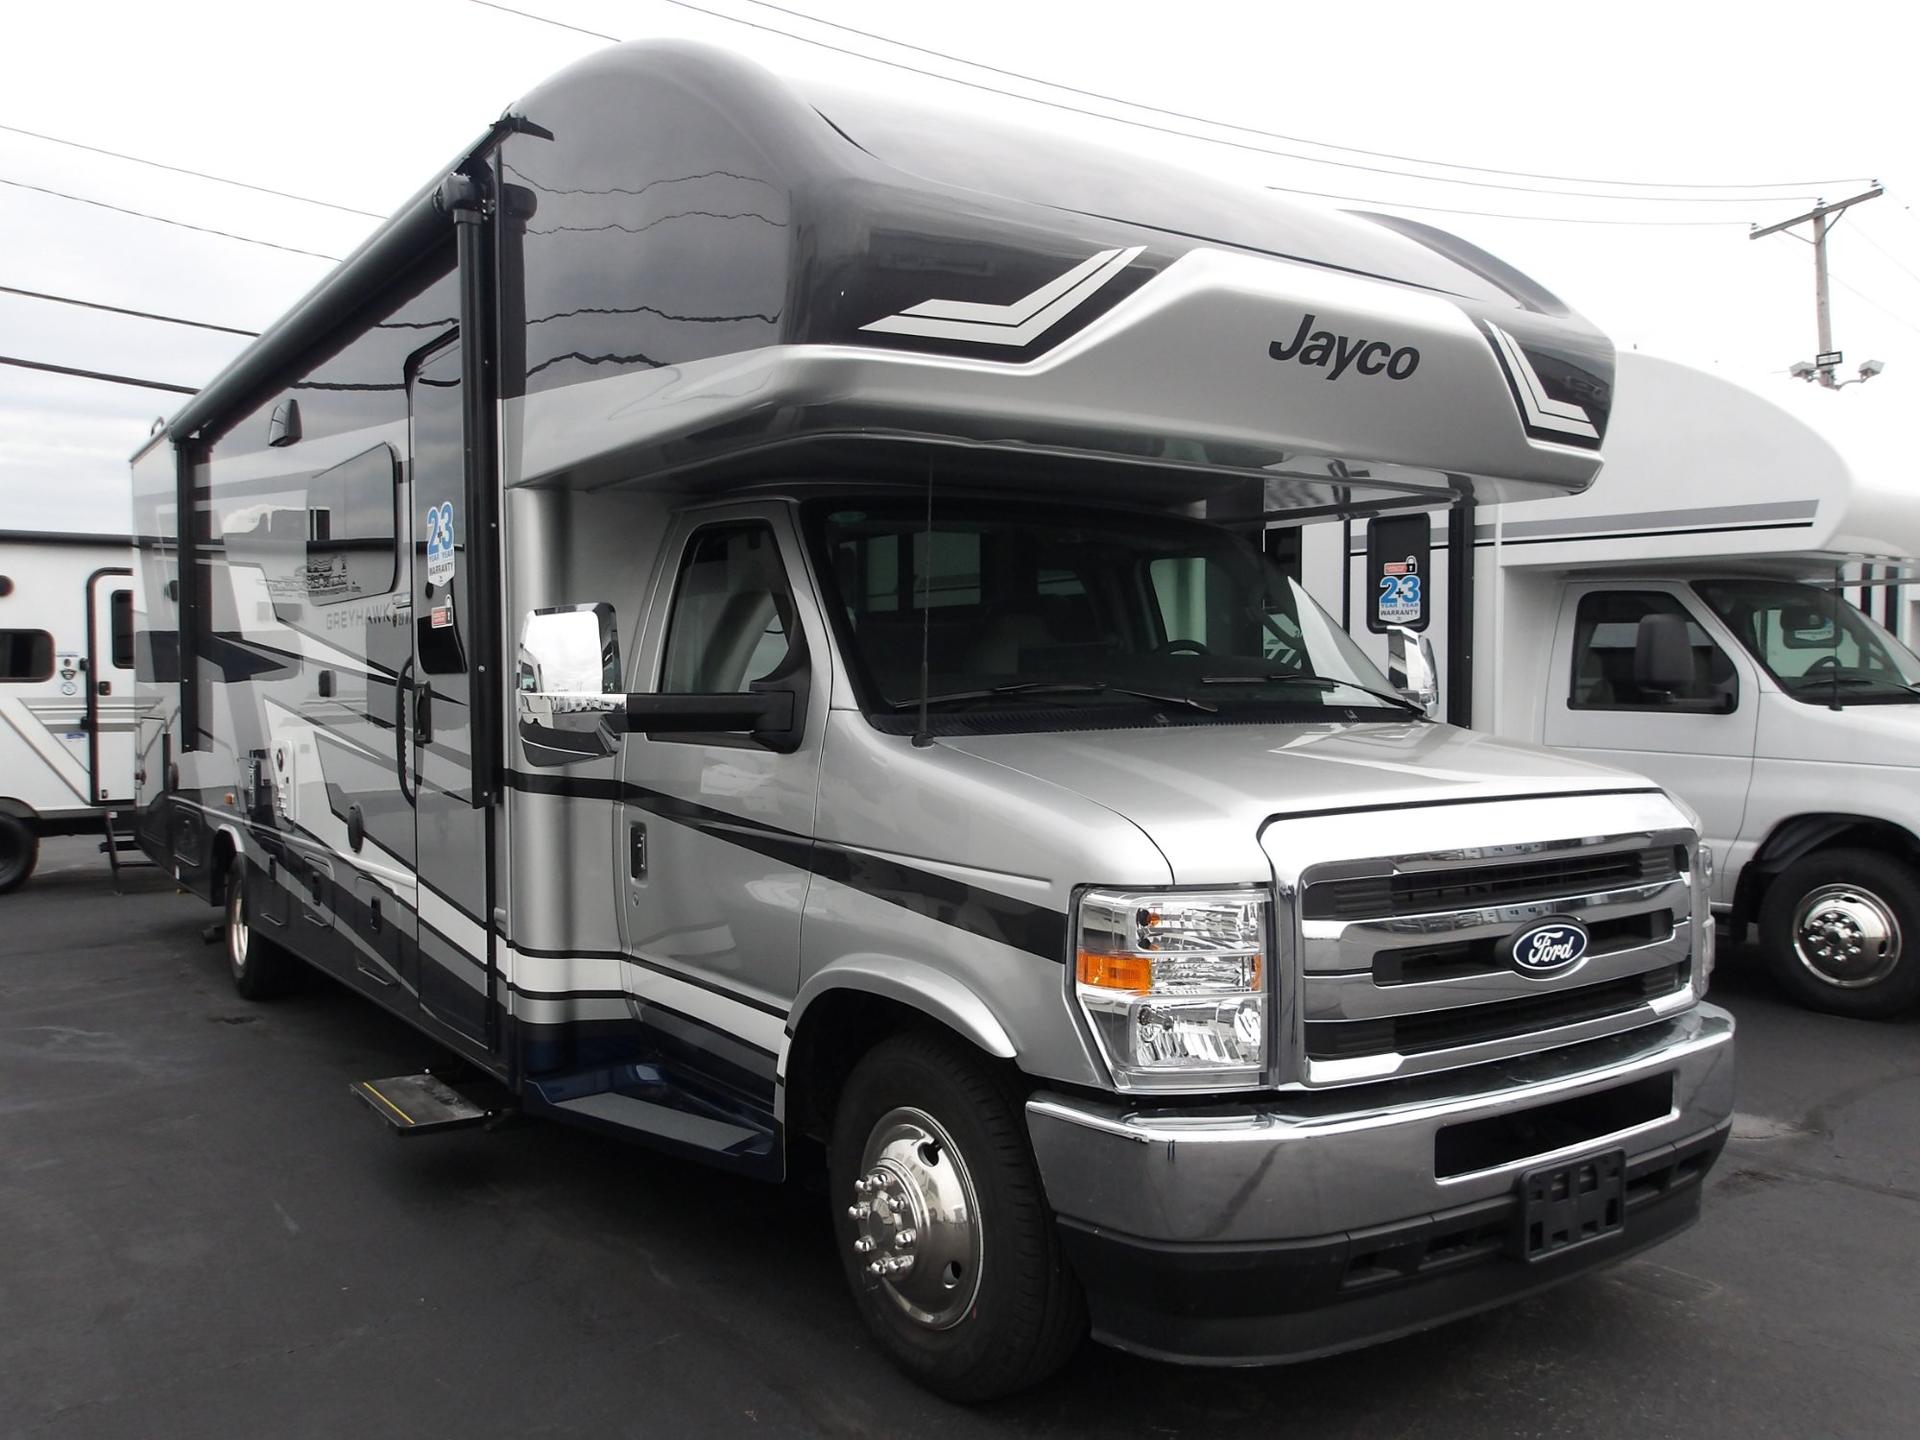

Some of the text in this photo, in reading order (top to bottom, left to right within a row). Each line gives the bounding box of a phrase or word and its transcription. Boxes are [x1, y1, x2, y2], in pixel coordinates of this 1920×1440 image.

[1268, 313, 1420, 381] Jayco
[429, 563, 454, 577] WARRANTY
[326, 603, 391, 630] GREYHAWK
[1528, 931, 1575, 964] Ford
